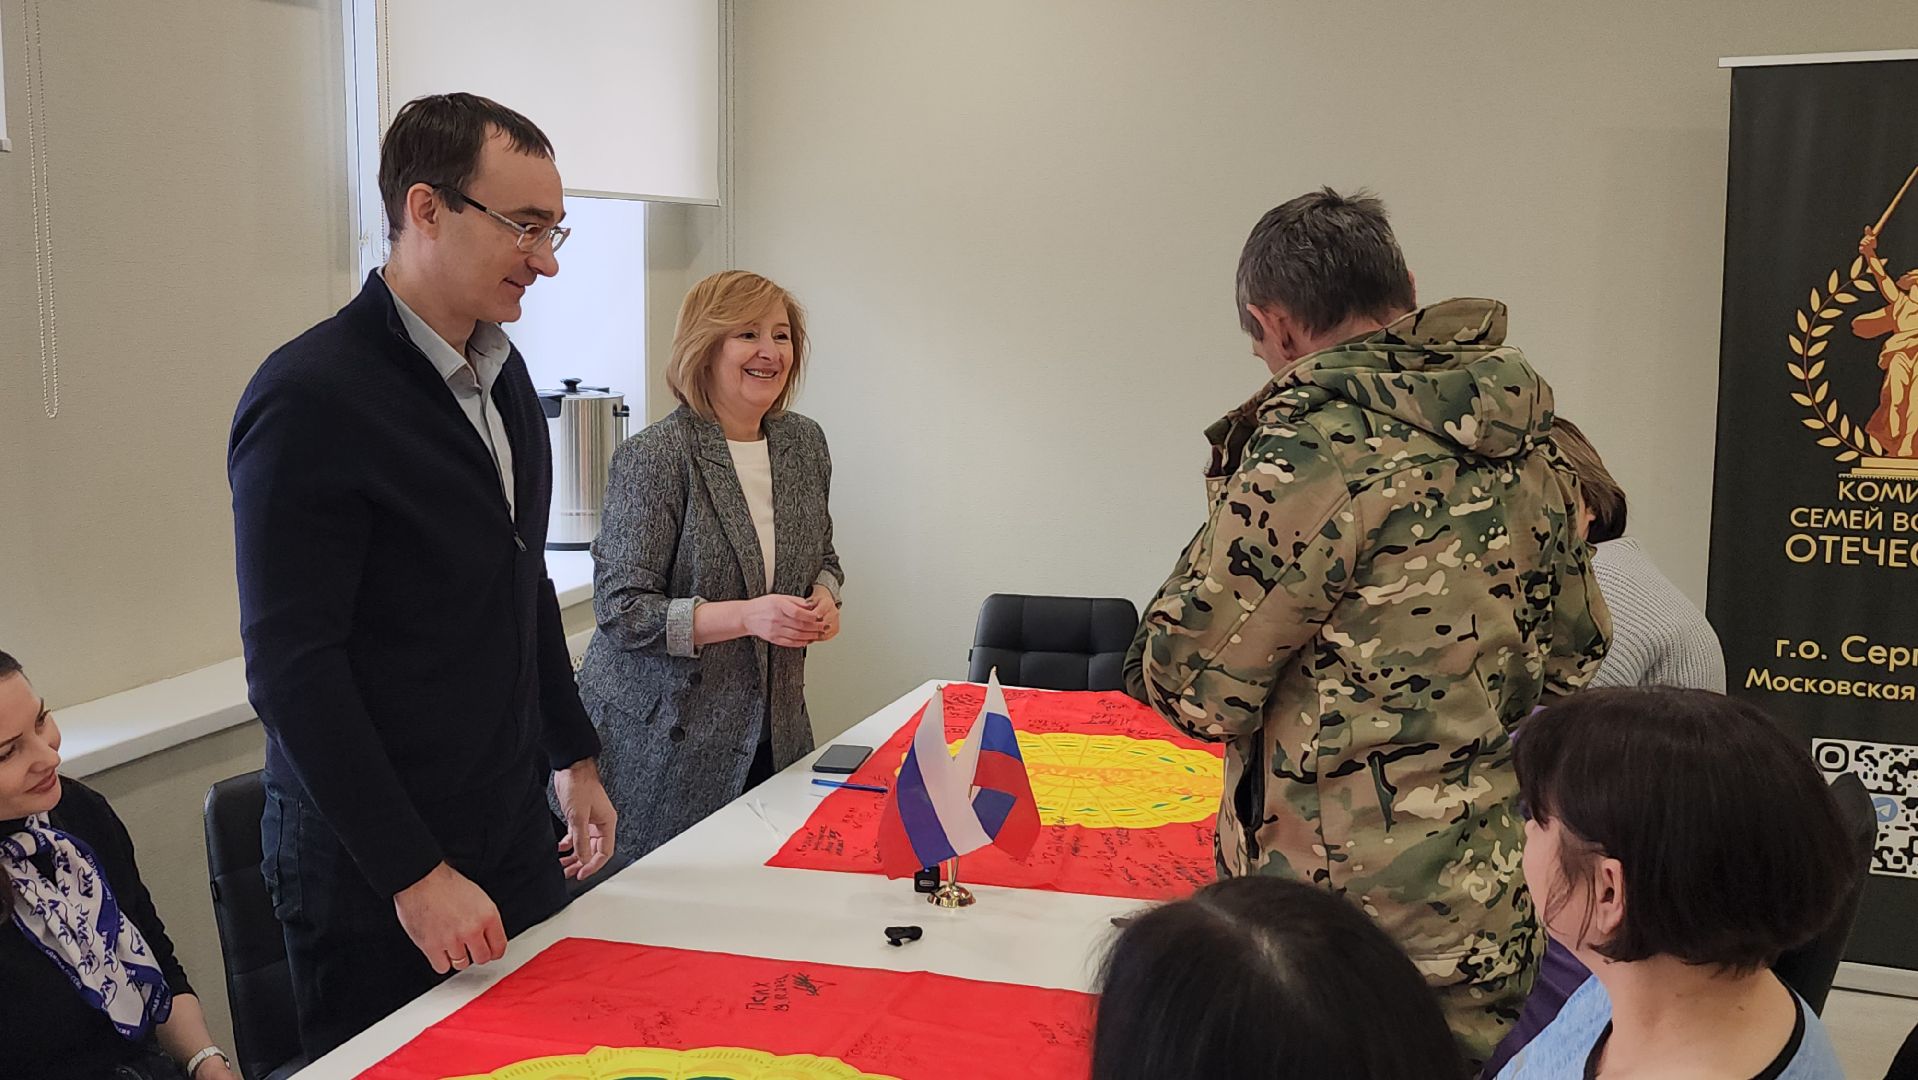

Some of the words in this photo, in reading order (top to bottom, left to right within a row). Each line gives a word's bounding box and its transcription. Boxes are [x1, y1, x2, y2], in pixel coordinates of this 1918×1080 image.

[1790, 505, 1882, 531] СЕМЕЙ
[1785, 533, 1918, 568] ОТЕЧЕ
[1776, 639, 1827, 660] г.о.
[1745, 667, 1917, 701] Московская
